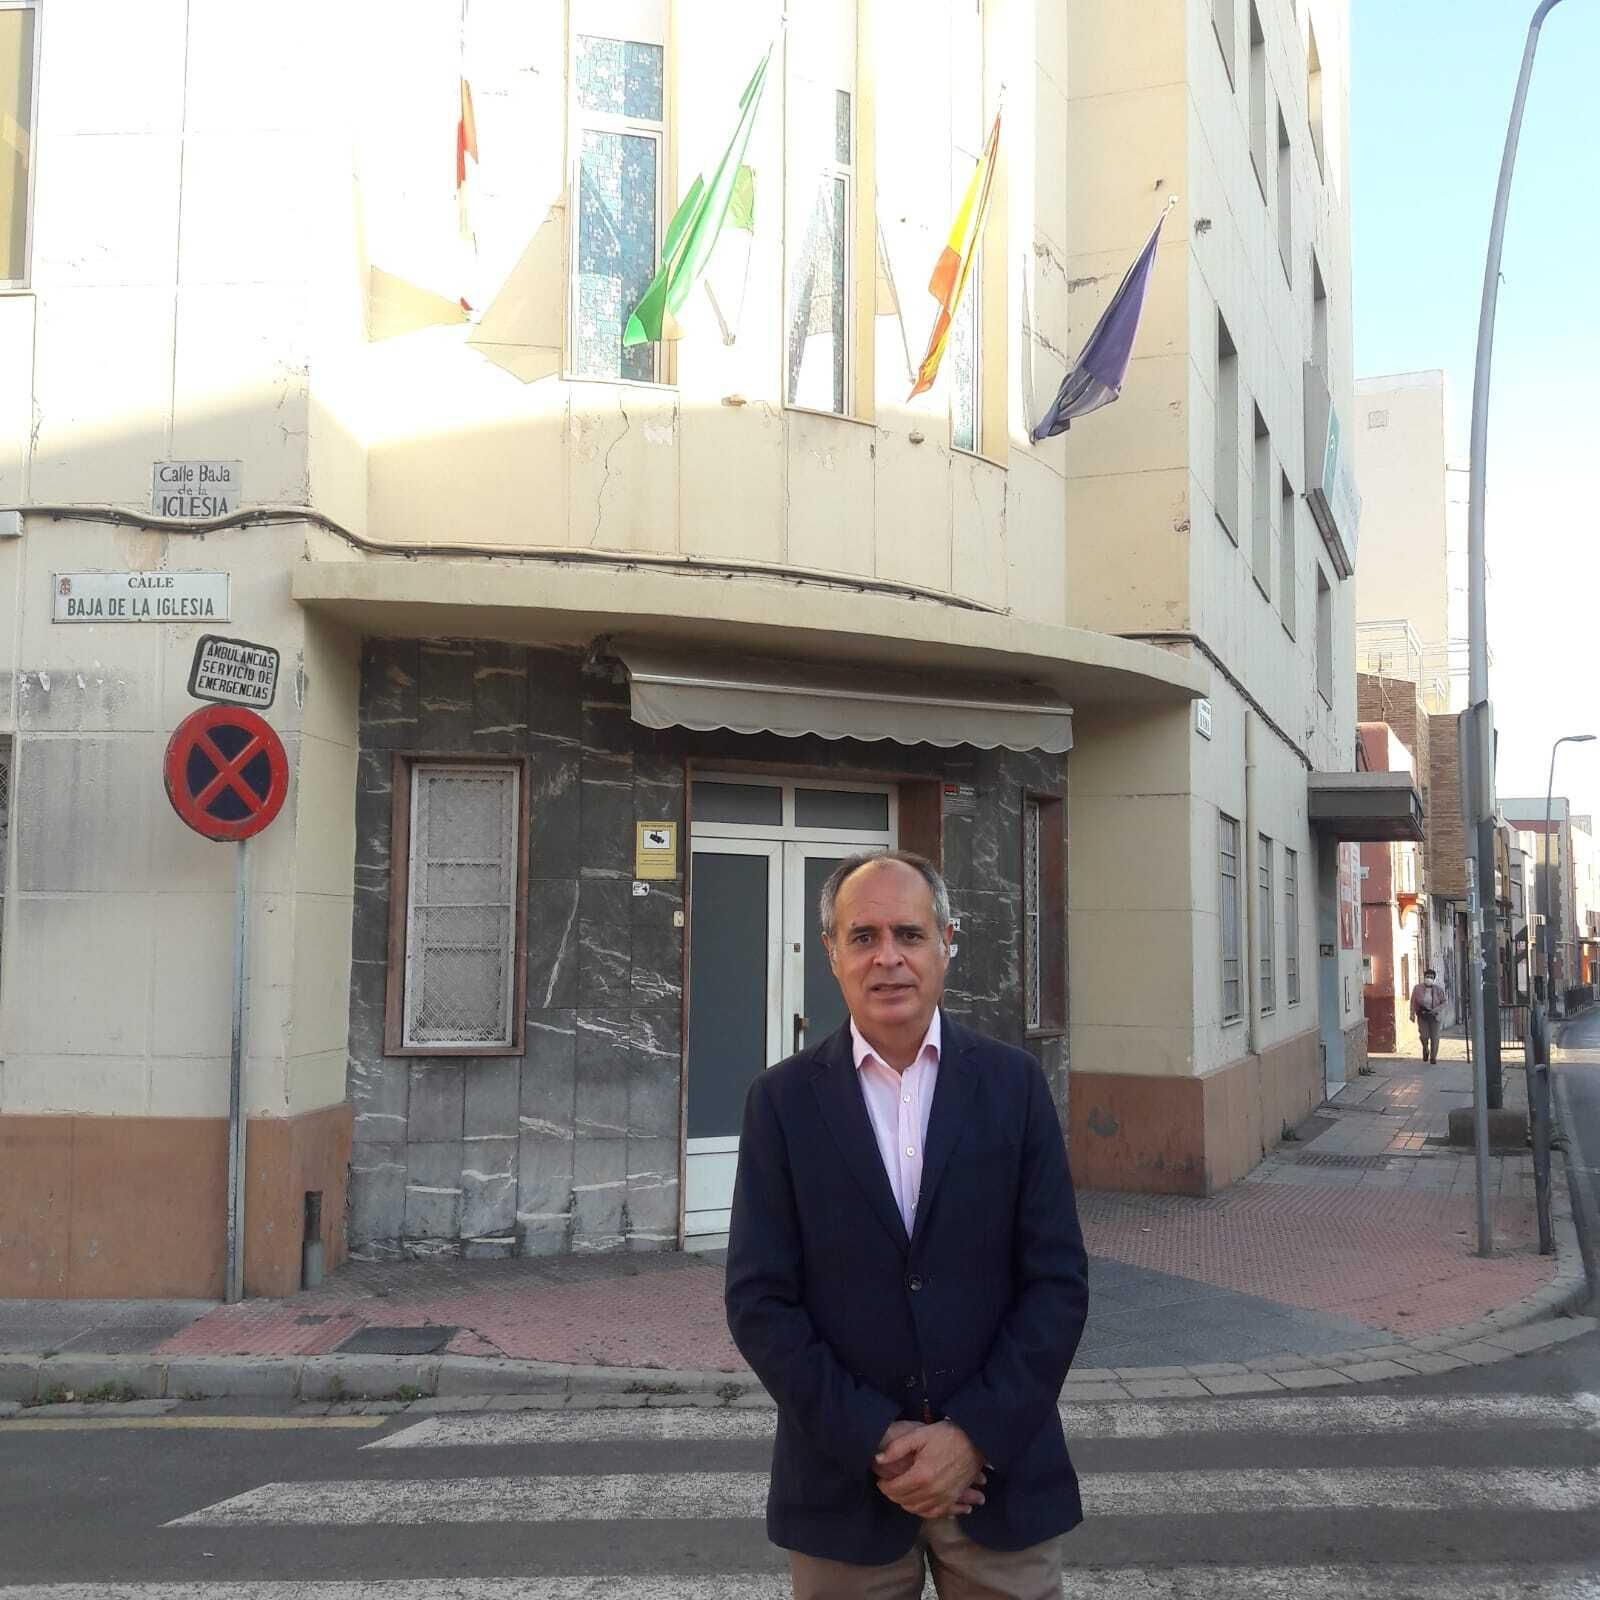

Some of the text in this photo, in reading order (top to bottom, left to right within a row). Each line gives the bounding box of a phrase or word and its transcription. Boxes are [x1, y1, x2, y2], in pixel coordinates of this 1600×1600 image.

[160, 464, 193, 482] Calle
[177, 483, 193, 496] de
[128, 577, 174, 589] CALLE
[67, 598, 214, 616] BAJA DE LA IGLESIA
[207, 643, 275, 668] AMBULANCIAS
[202, 660, 273, 685] SERVICIO DE
[198, 675, 269, 700] EMERGENCIAS
